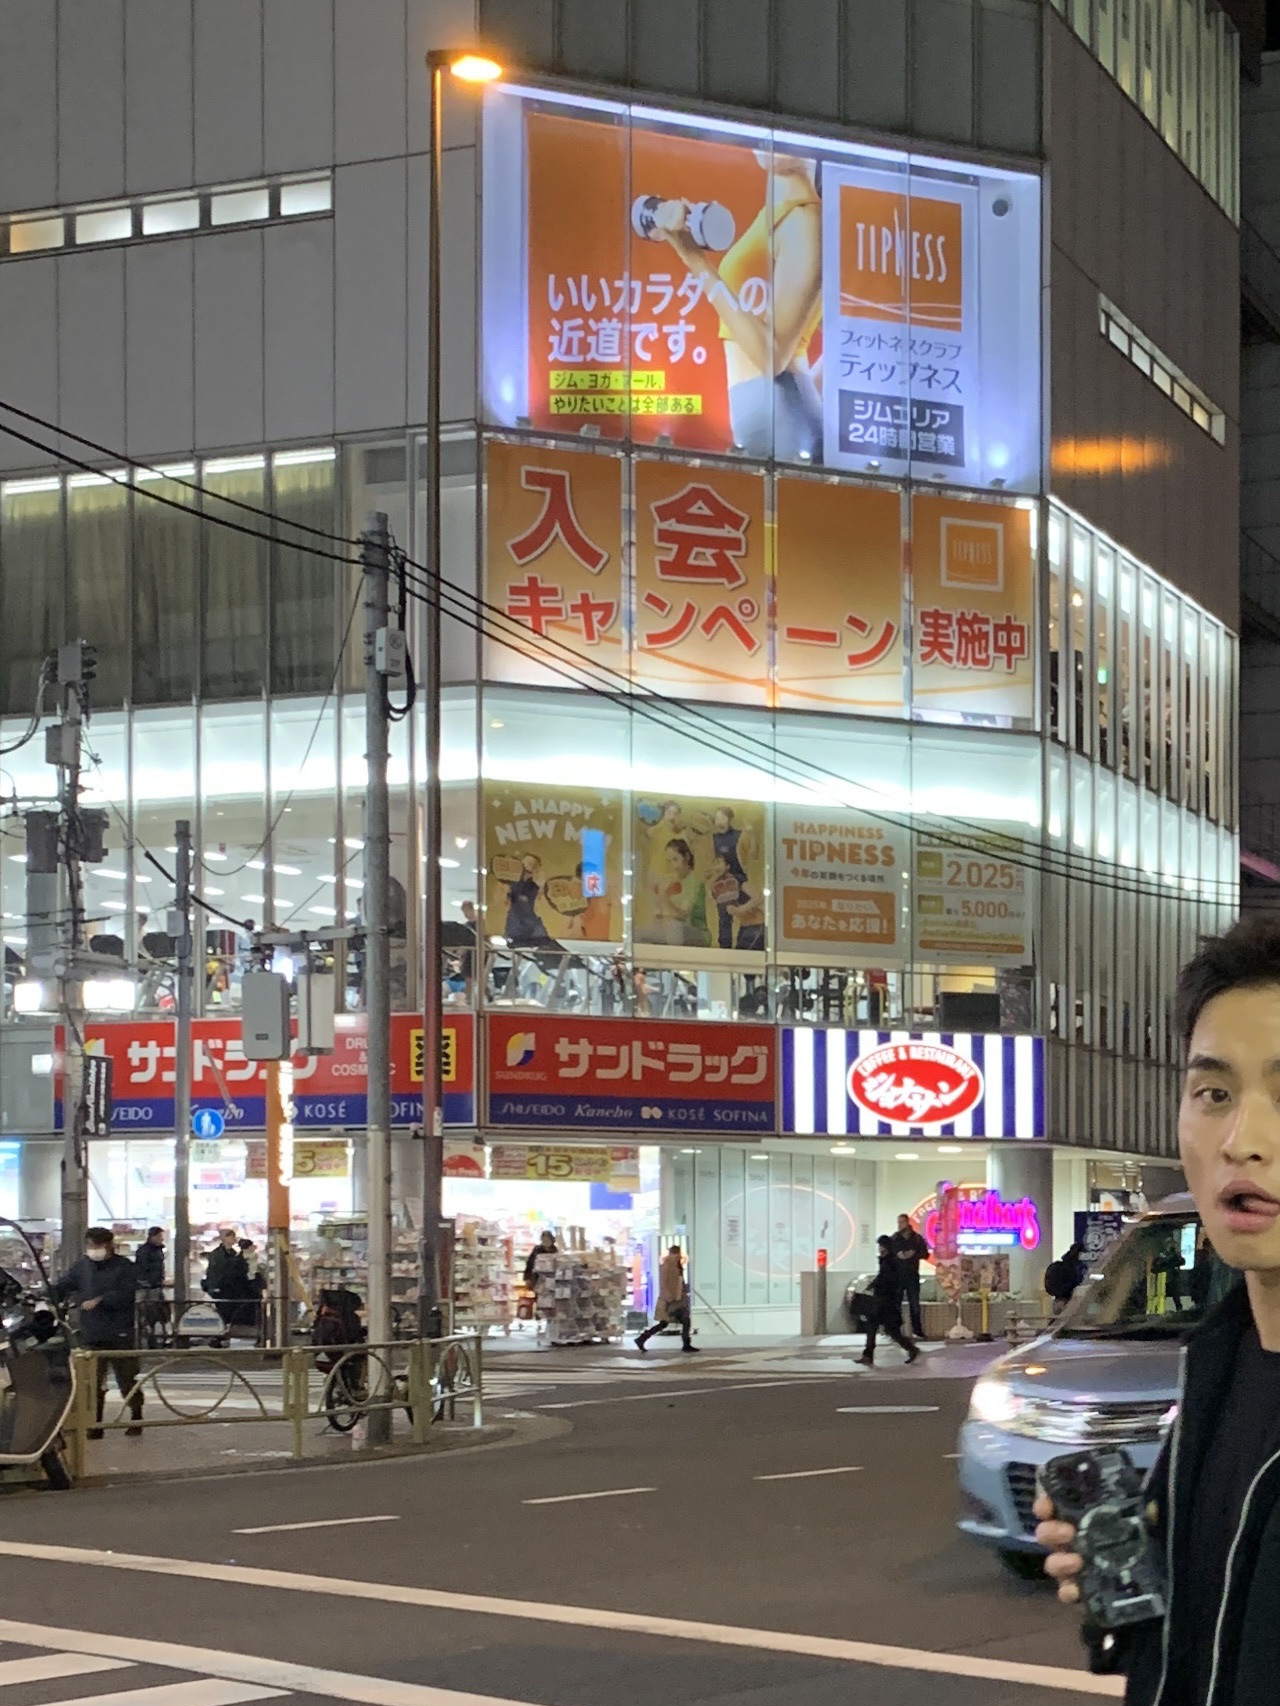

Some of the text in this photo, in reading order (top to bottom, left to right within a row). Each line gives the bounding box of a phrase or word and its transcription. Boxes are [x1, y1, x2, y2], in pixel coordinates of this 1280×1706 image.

[855, 206, 948, 297] TIPNESS
[547, 271, 769, 317] いいカラダへの
[547, 317, 708, 364] 近道です。
[853, 398, 951, 429] ジムエリア
[505, 464, 752, 590] 入会
[530, 798, 595, 820] HAPPY
[494, 819, 557, 846] NEW
[793, 821, 885, 840] HAPPINESS
[782, 837, 896, 868] TIPNESS
[554, 1037, 769, 1085] サンドラッグ
[303, 1102, 347, 1119] KOSÉ
[501, 1102, 566, 1116] SHISEIDO
[574, 1103, 634, 1120] Kanebo
[713, 1108, 768, 1123] SOFINA
[527, 1153, 574, 1178] 15
